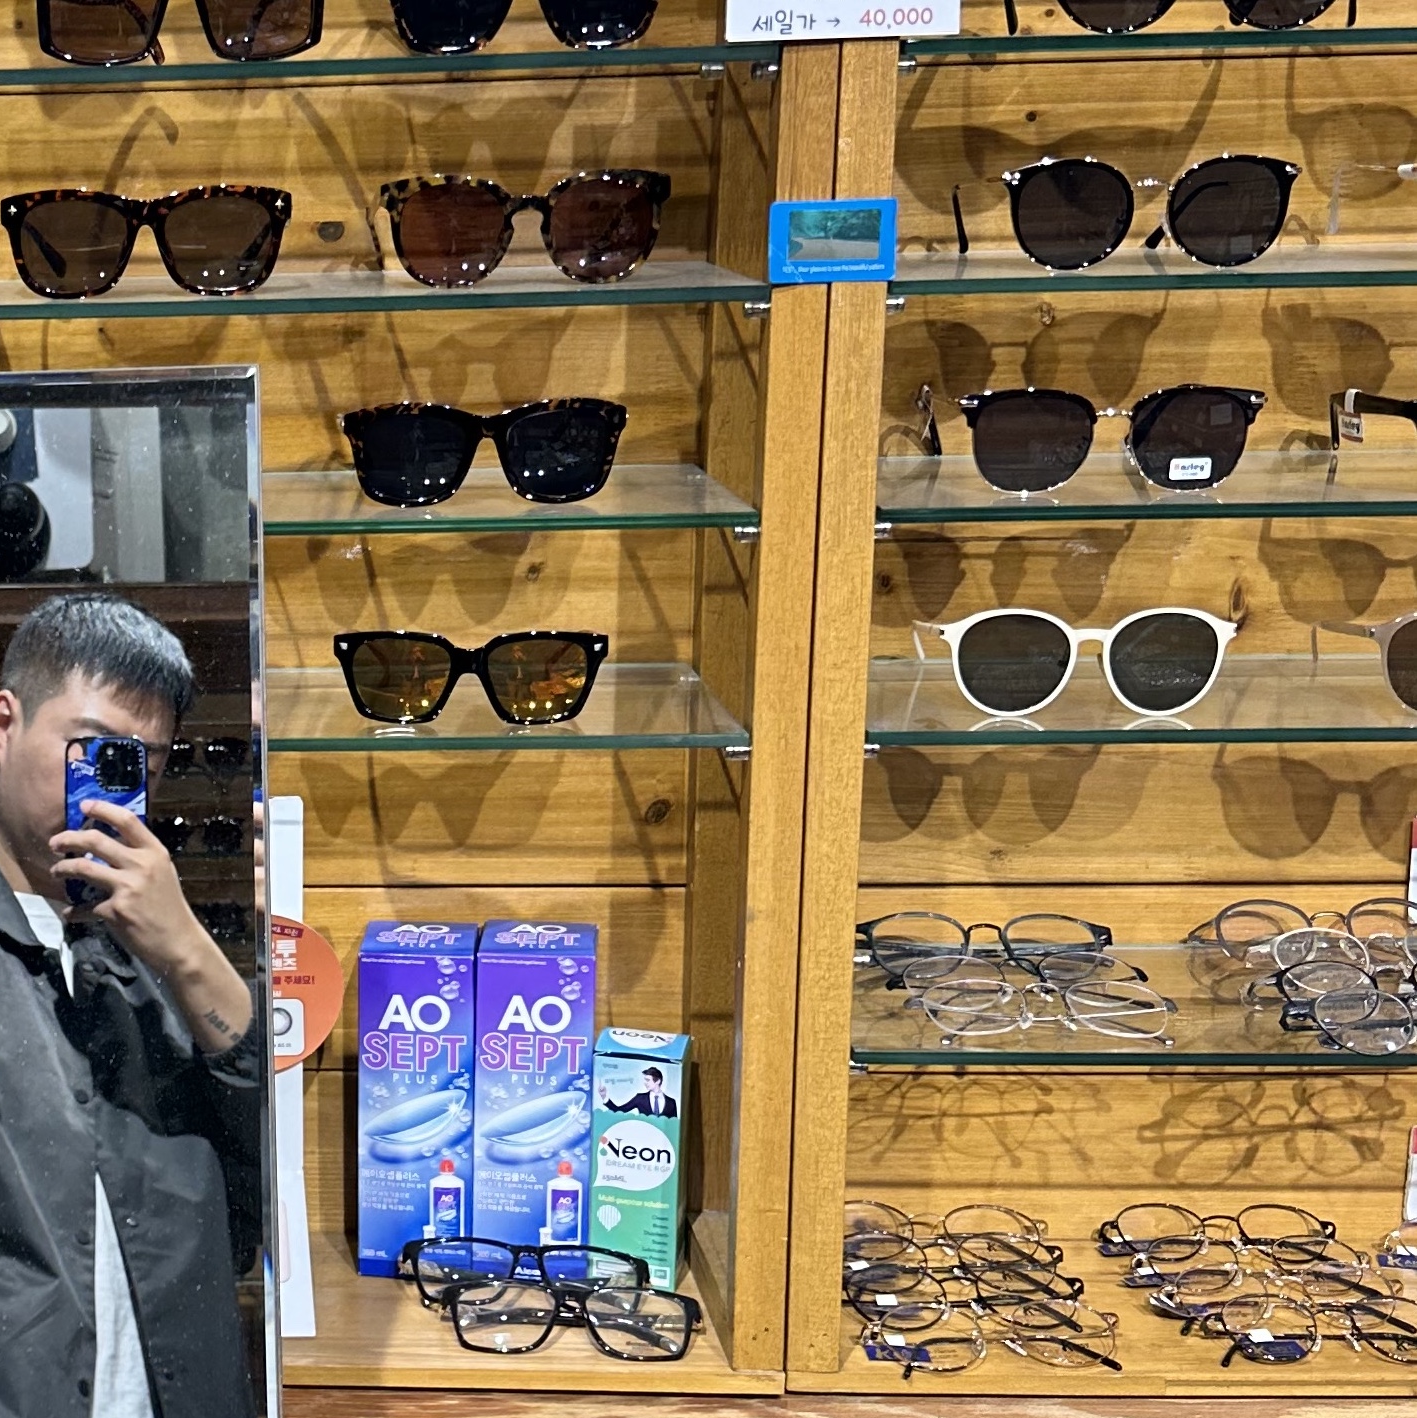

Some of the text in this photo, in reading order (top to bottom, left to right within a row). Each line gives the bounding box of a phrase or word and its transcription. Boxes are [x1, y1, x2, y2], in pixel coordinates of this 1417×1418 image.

[752, 8, 933, 35] 세일가 40,000
[392, 923, 451, 934] AO
[510, 923, 568, 934] AO
[376, 931, 462, 945] SEPT
[494, 932, 581, 946] SEPT
[378, 994, 451, 1033] AO
[497, 994, 572, 1033] AO
[362, 1031, 468, 1073] SEPT
[480, 1032, 587, 1074] SEPT
[393, 1073, 438, 1084] PLUS
[511, 1074, 557, 1086] PLUS
[607, 1138, 671, 1164] Neon
[606, 1160, 635, 1169] DREAM
[637, 1163, 653, 1171] EYE
